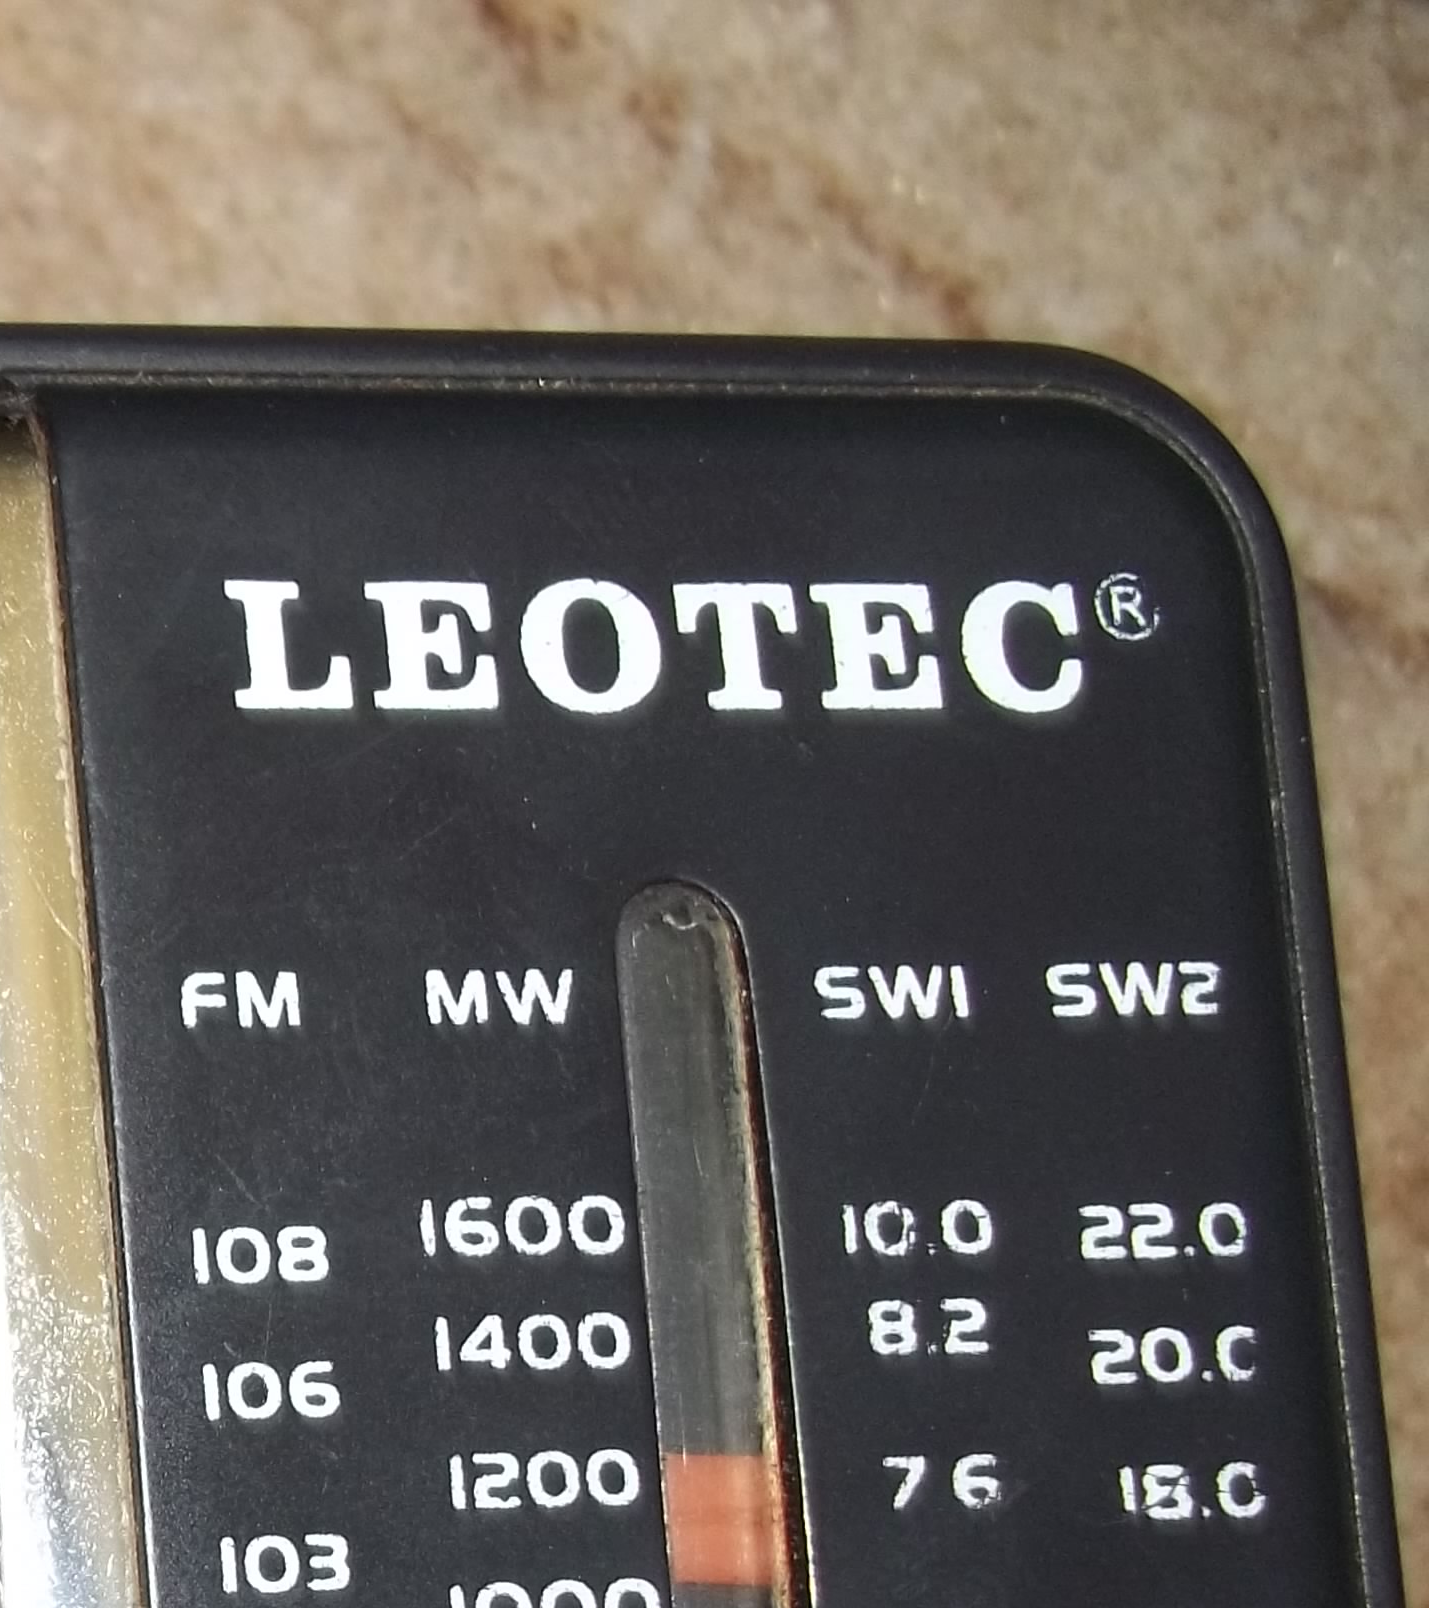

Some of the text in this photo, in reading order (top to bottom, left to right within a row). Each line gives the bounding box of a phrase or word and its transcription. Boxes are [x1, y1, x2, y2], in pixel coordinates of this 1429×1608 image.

[225, 578, 1082, 714] LEOTEC
[181, 971, 300, 1028] FM
[426, 969, 572, 1025] MW
[1046, 962, 1219, 1016] SW2
[193, 1226, 329, 1284] 108
[420, 1196, 625, 1257] 1600
[843, 1200, 993, 1256] 10.0
[1080, 1203, 1246, 1259] 22.0
[436, 1313, 630, 1370] 1400
[203, 1361, 340, 1421] 106
[450, 1450, 639, 1509] 1200
[883, 1454, 999, 1508] 76
[221, 1534, 350, 1593] 103
